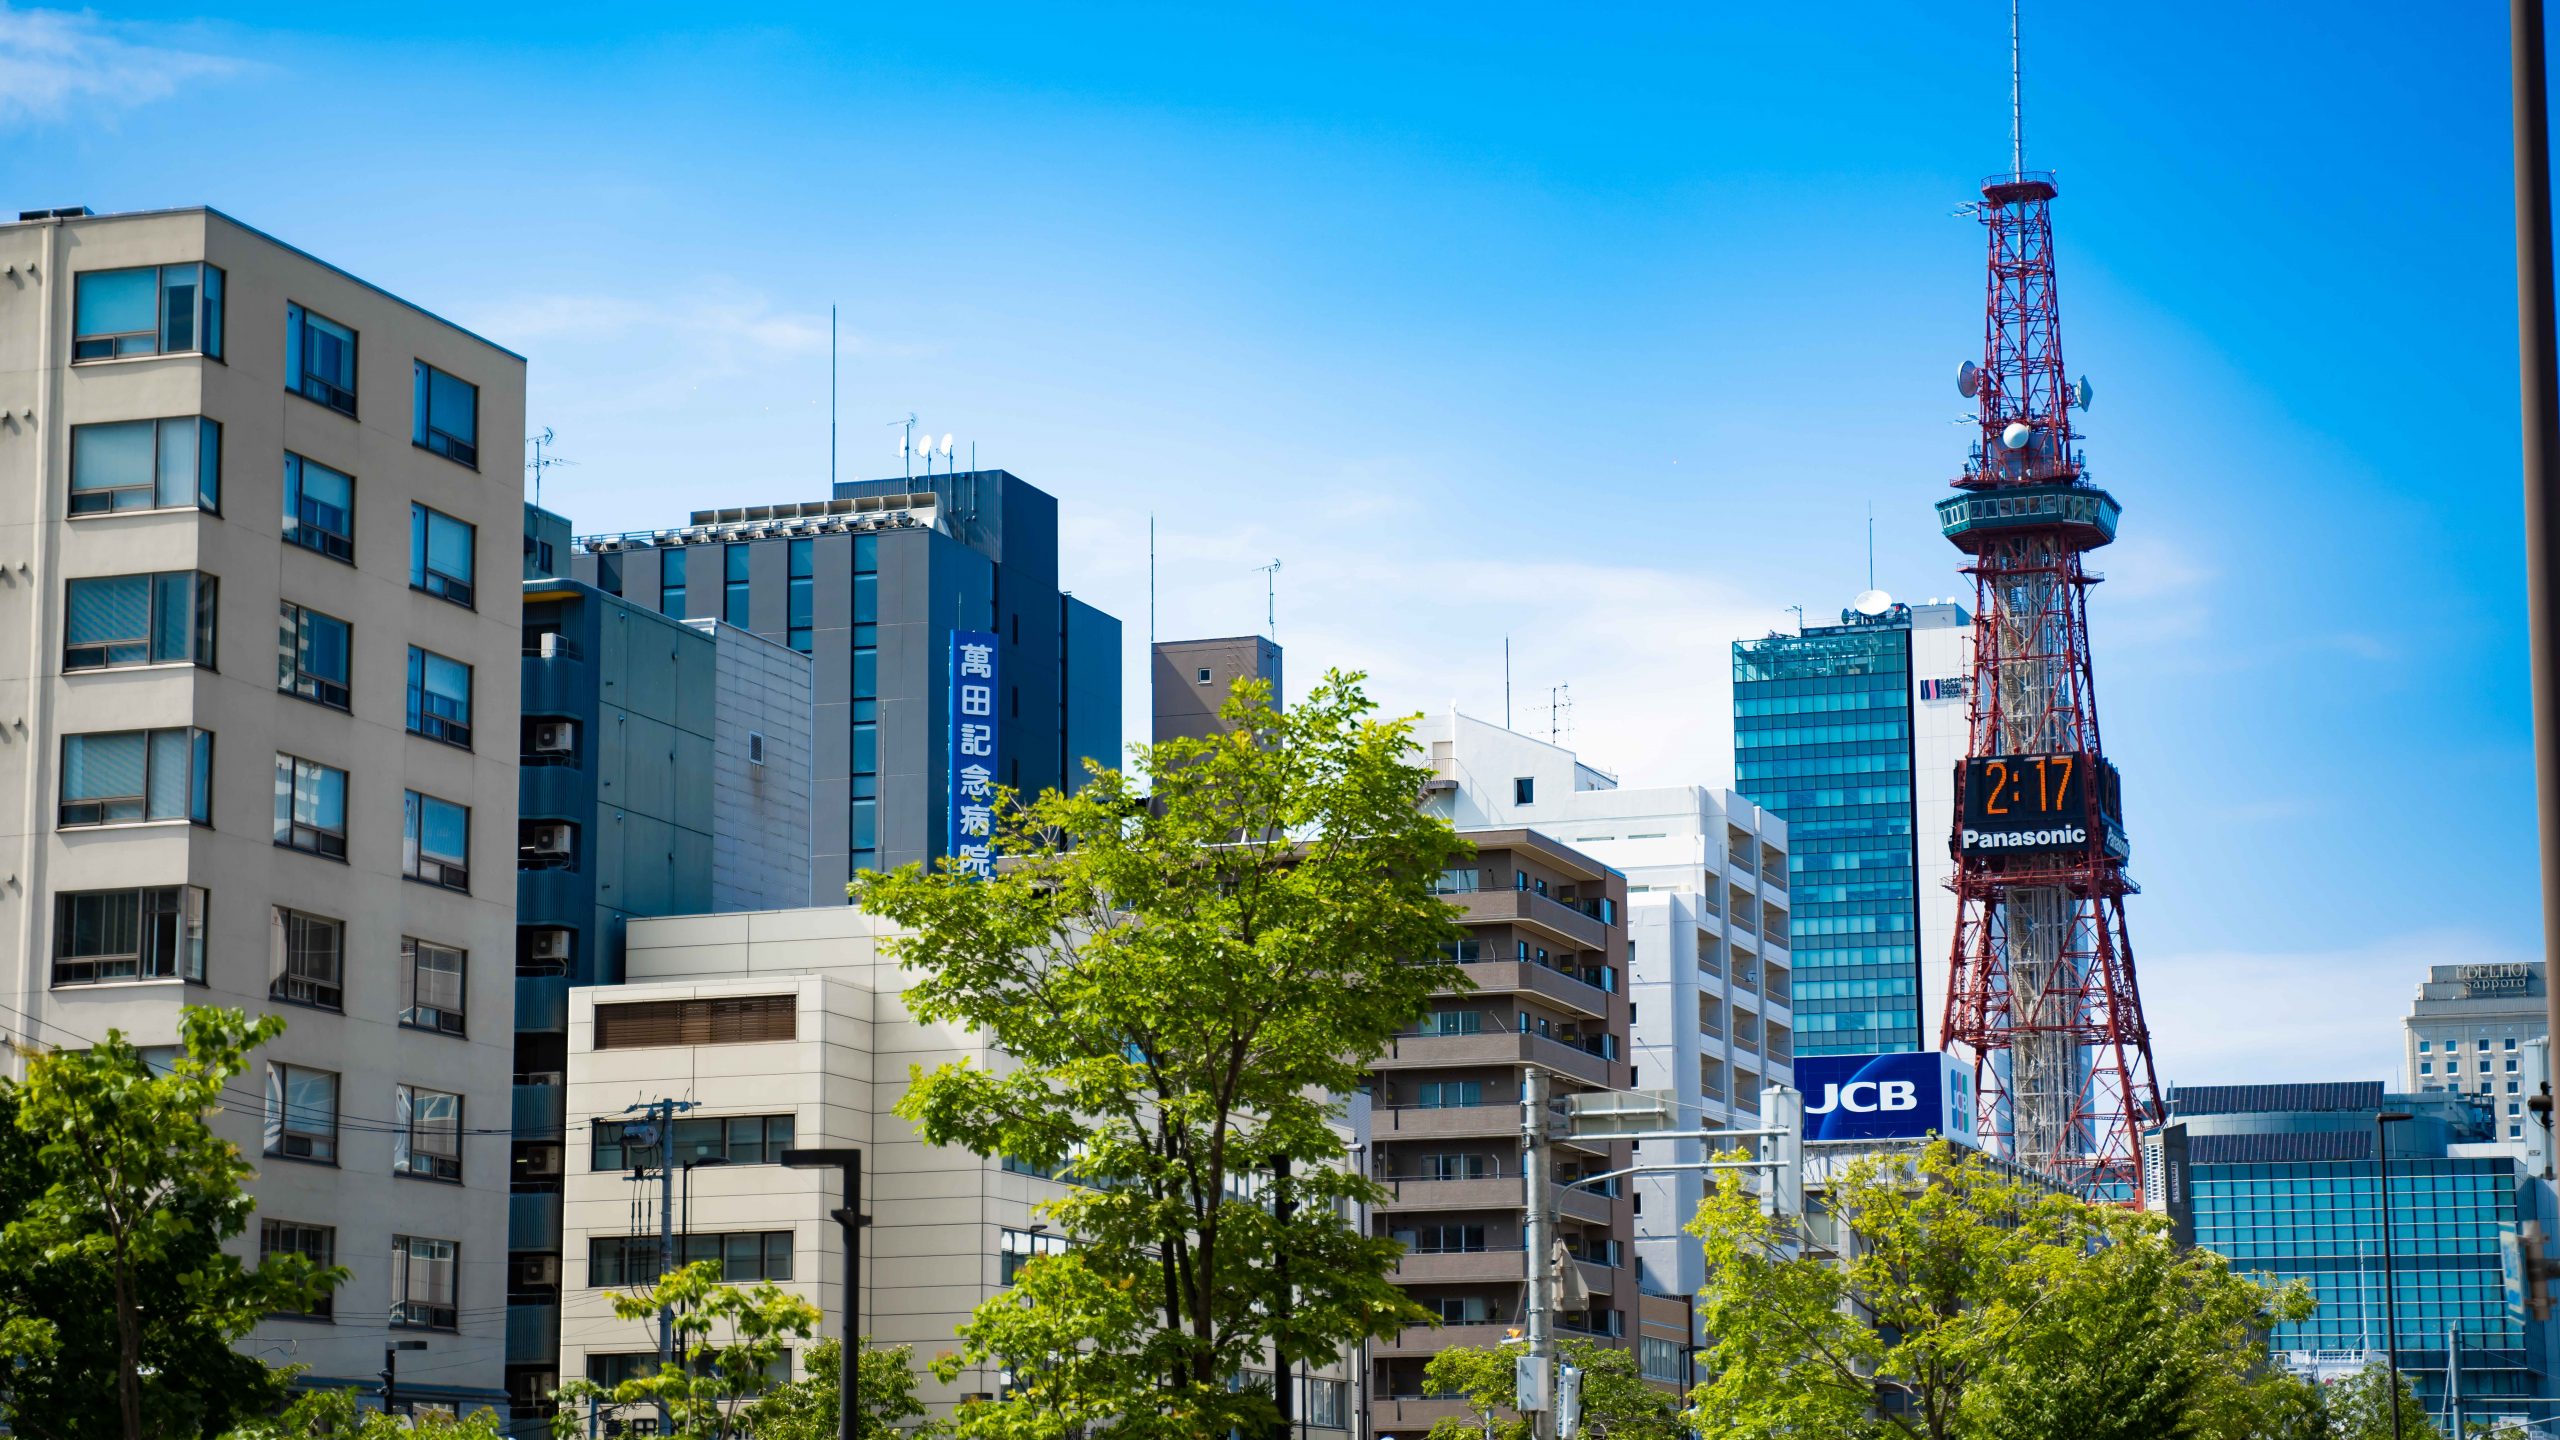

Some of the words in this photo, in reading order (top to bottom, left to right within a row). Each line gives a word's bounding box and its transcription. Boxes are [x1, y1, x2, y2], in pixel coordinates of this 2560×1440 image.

[960, 643, 993, 877] 萬田記念病院
[1986, 758, 2073, 815] 2:17
[1962, 824, 2086, 849] Panasonic
[1805, 1080, 1918, 1114] JCB
[1951, 1089, 1968, 1114] JCB
